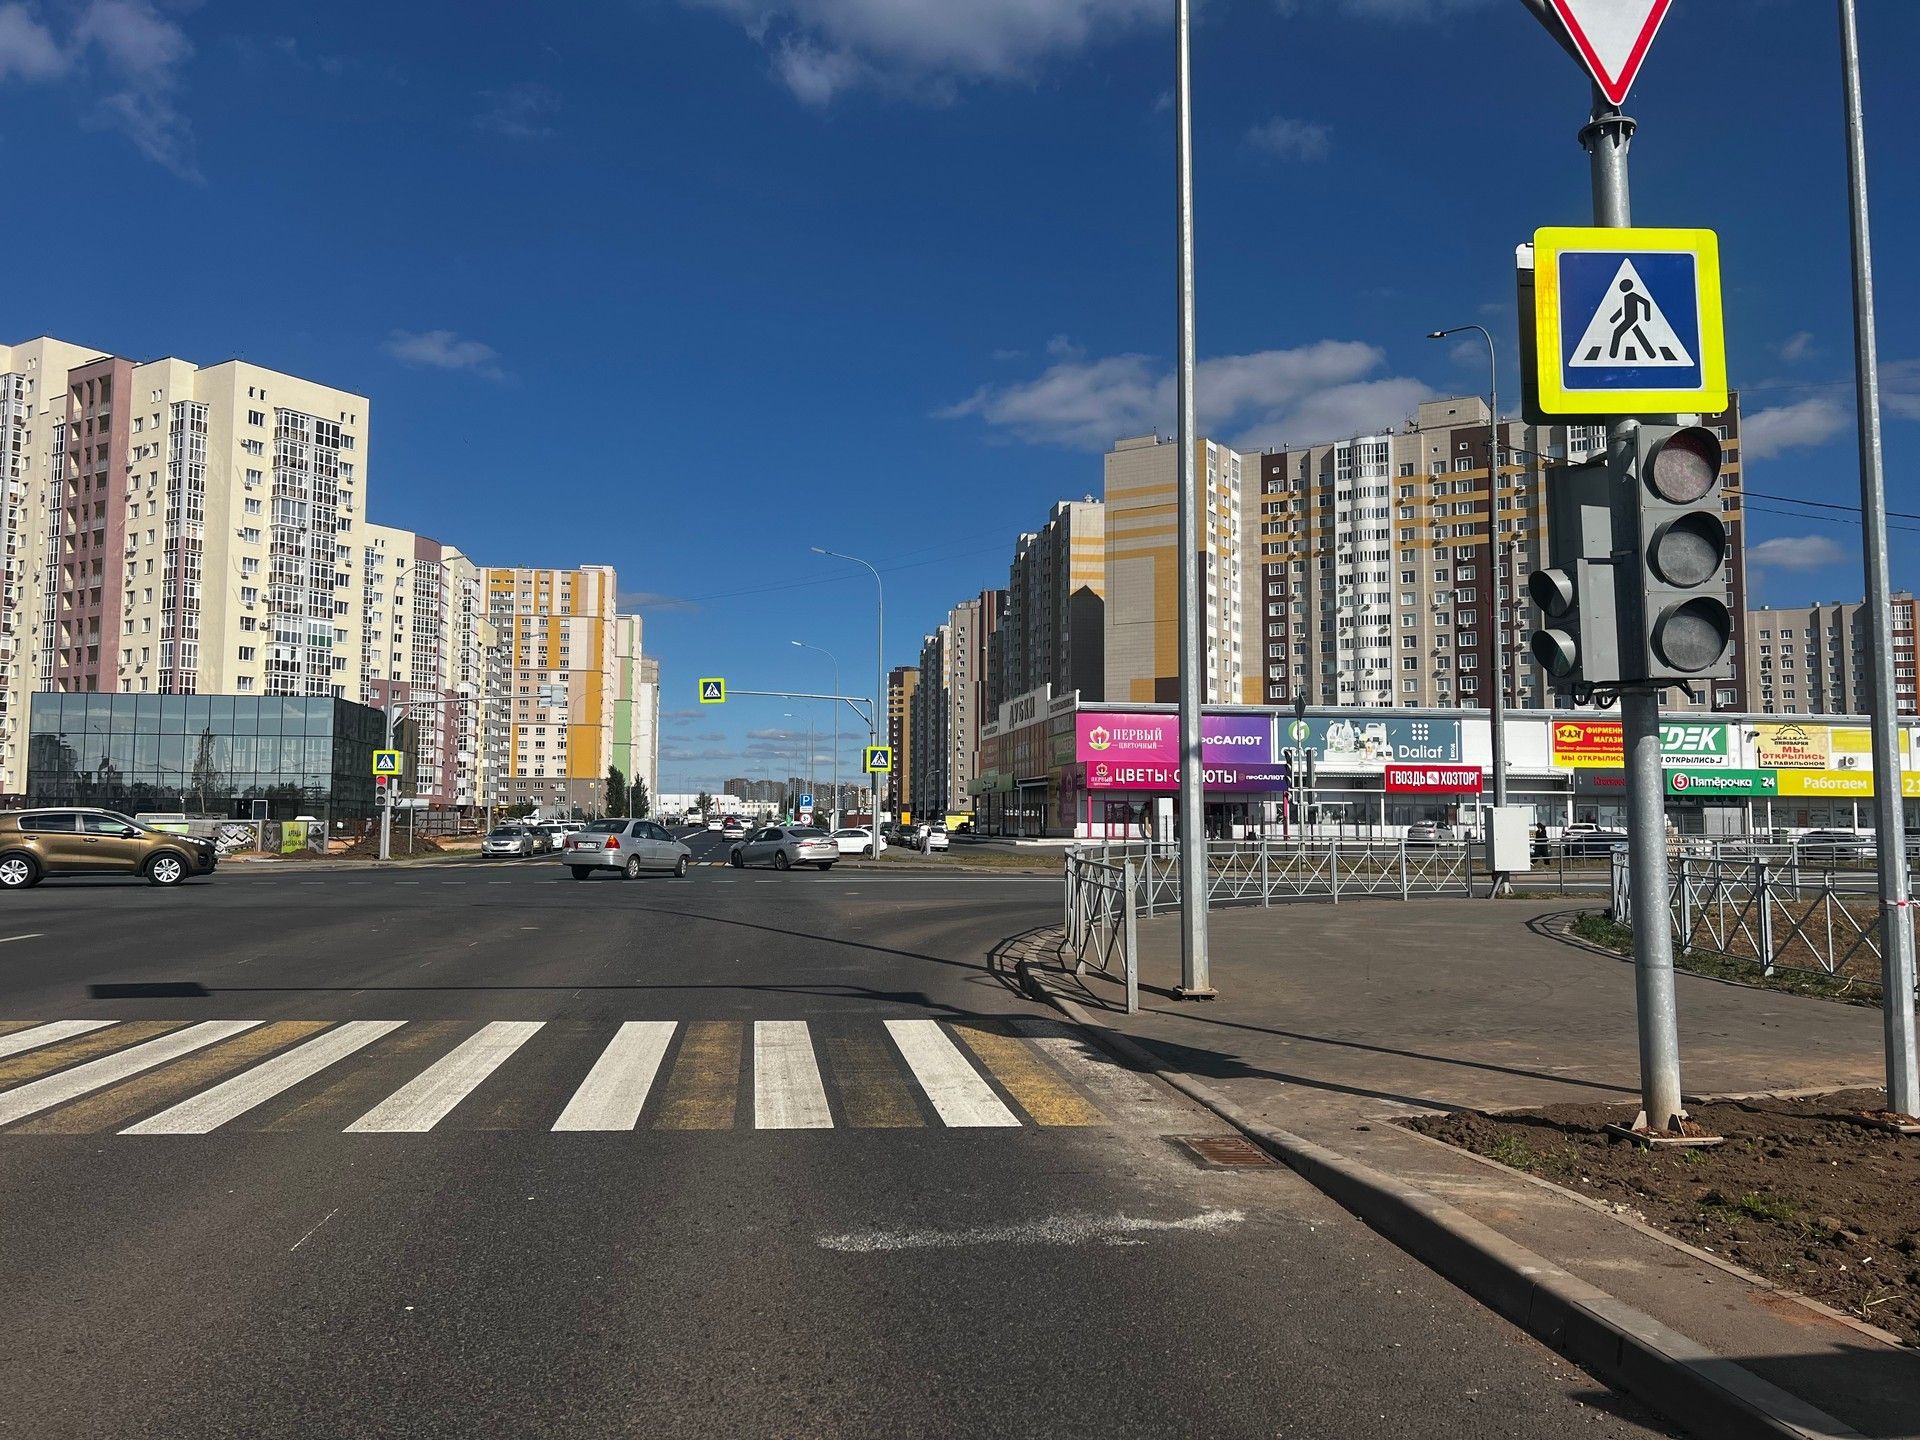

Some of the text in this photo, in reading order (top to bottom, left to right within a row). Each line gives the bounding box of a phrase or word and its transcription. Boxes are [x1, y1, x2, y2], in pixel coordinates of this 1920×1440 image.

[1009, 696, 1035, 730] ДУБКИ
[1113, 728, 1162, 741] ПЕРВЫЙ
[1660, 726, 1721, 751] DEK
[1118, 742, 1157, 750] ЦВЕТОЧНЫЙ
[1399, 745, 1443, 758] Daliaf
[1174, 769, 1237, 783] СЮТЫ
[1390, 771, 1479, 786] ГВОЗДЬ ХОЗТОРГ
[1690, 776, 1775, 788] Пятёрочка 24
[1803, 776, 1868, 790] Работаем
